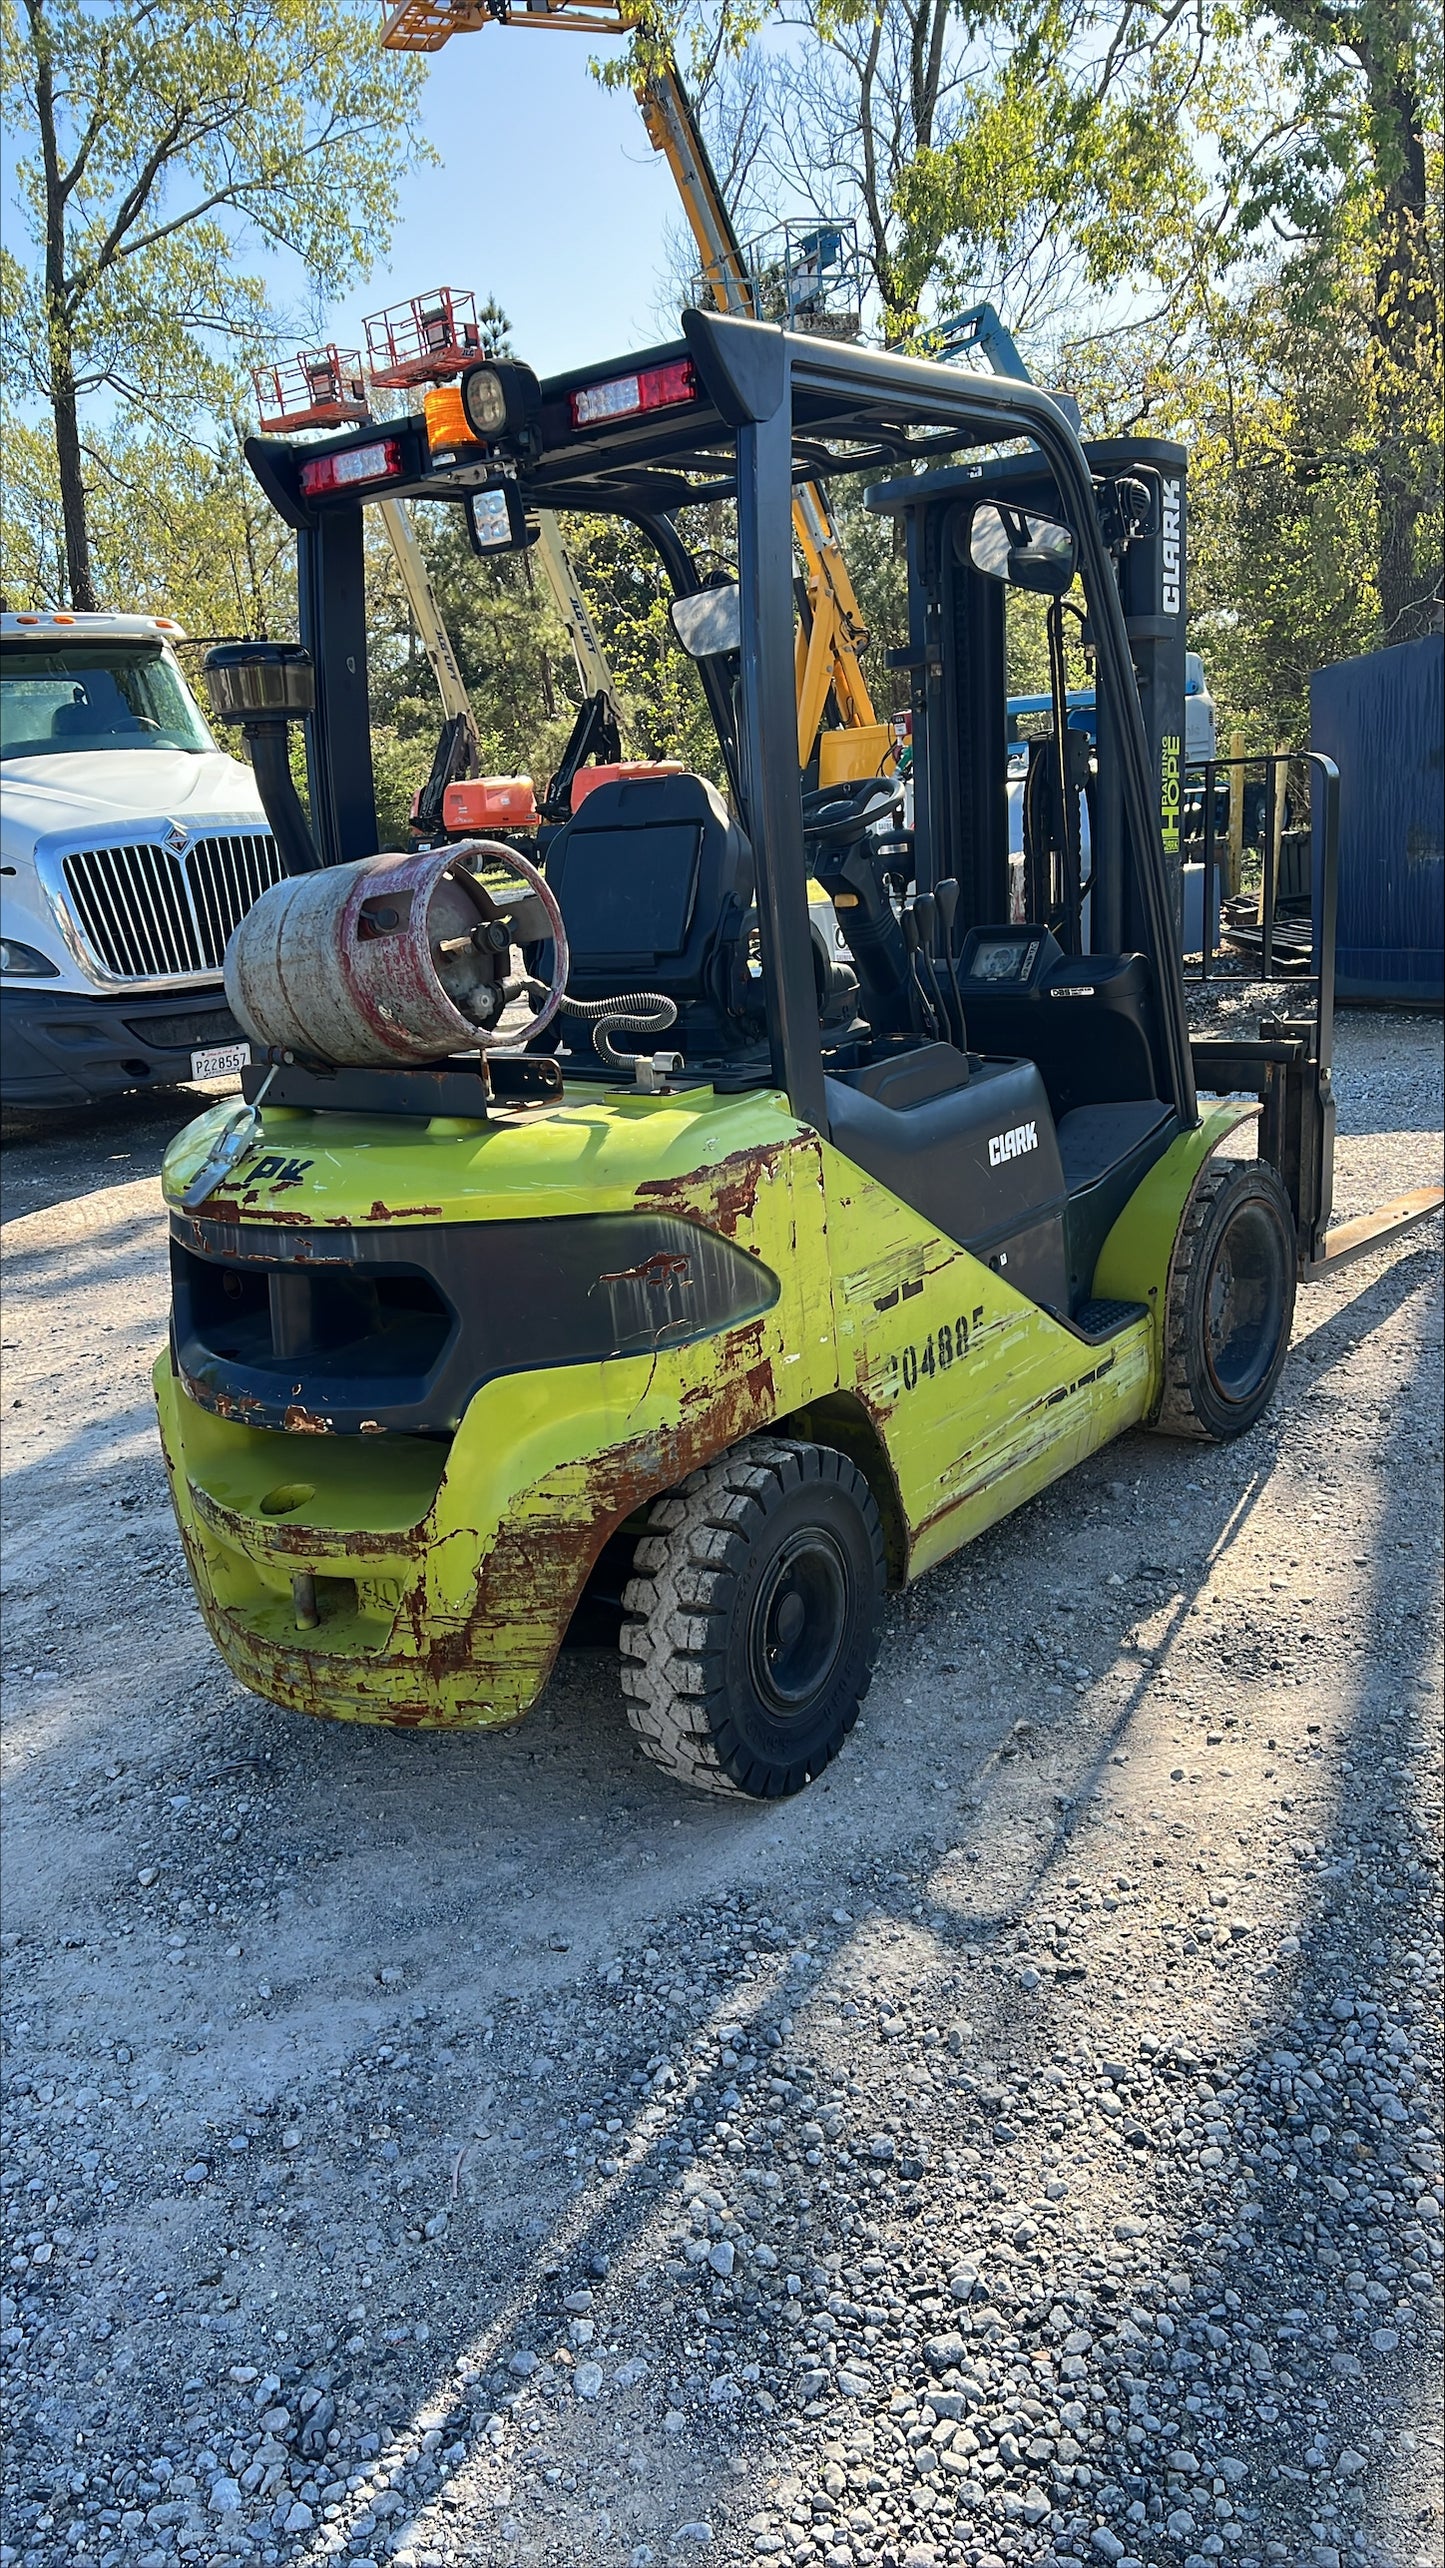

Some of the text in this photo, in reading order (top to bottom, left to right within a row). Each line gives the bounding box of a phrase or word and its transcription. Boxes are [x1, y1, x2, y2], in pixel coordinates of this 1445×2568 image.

[1162, 479, 1181, 614] CLARK
[569, 597, 596, 653] JLG LIFT
[1161, 736, 1180, 838] HOPE
[196, 1052, 246, 1074] P228557
[988, 1120, 1038, 1167] CLARK
